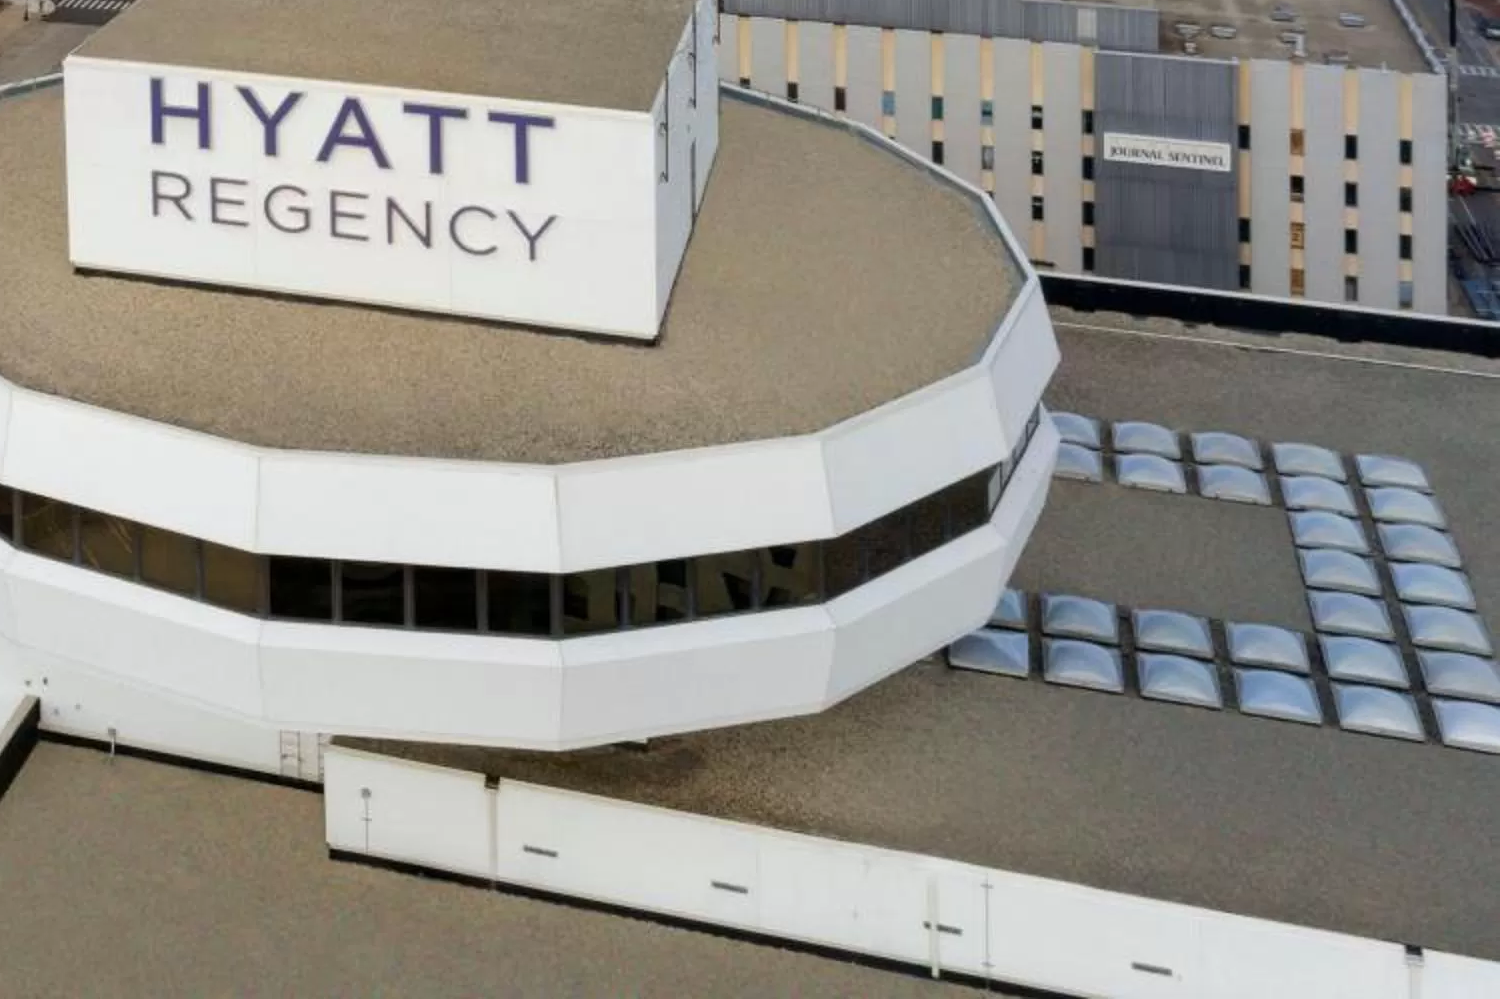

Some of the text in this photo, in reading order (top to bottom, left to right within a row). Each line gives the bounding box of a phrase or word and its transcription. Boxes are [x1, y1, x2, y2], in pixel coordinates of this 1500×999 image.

[149, 77, 556, 185] HYATT
[1110, 145, 1224, 166] JOURNAL SENTINEL
[150, 170, 558, 262] REGENCY
